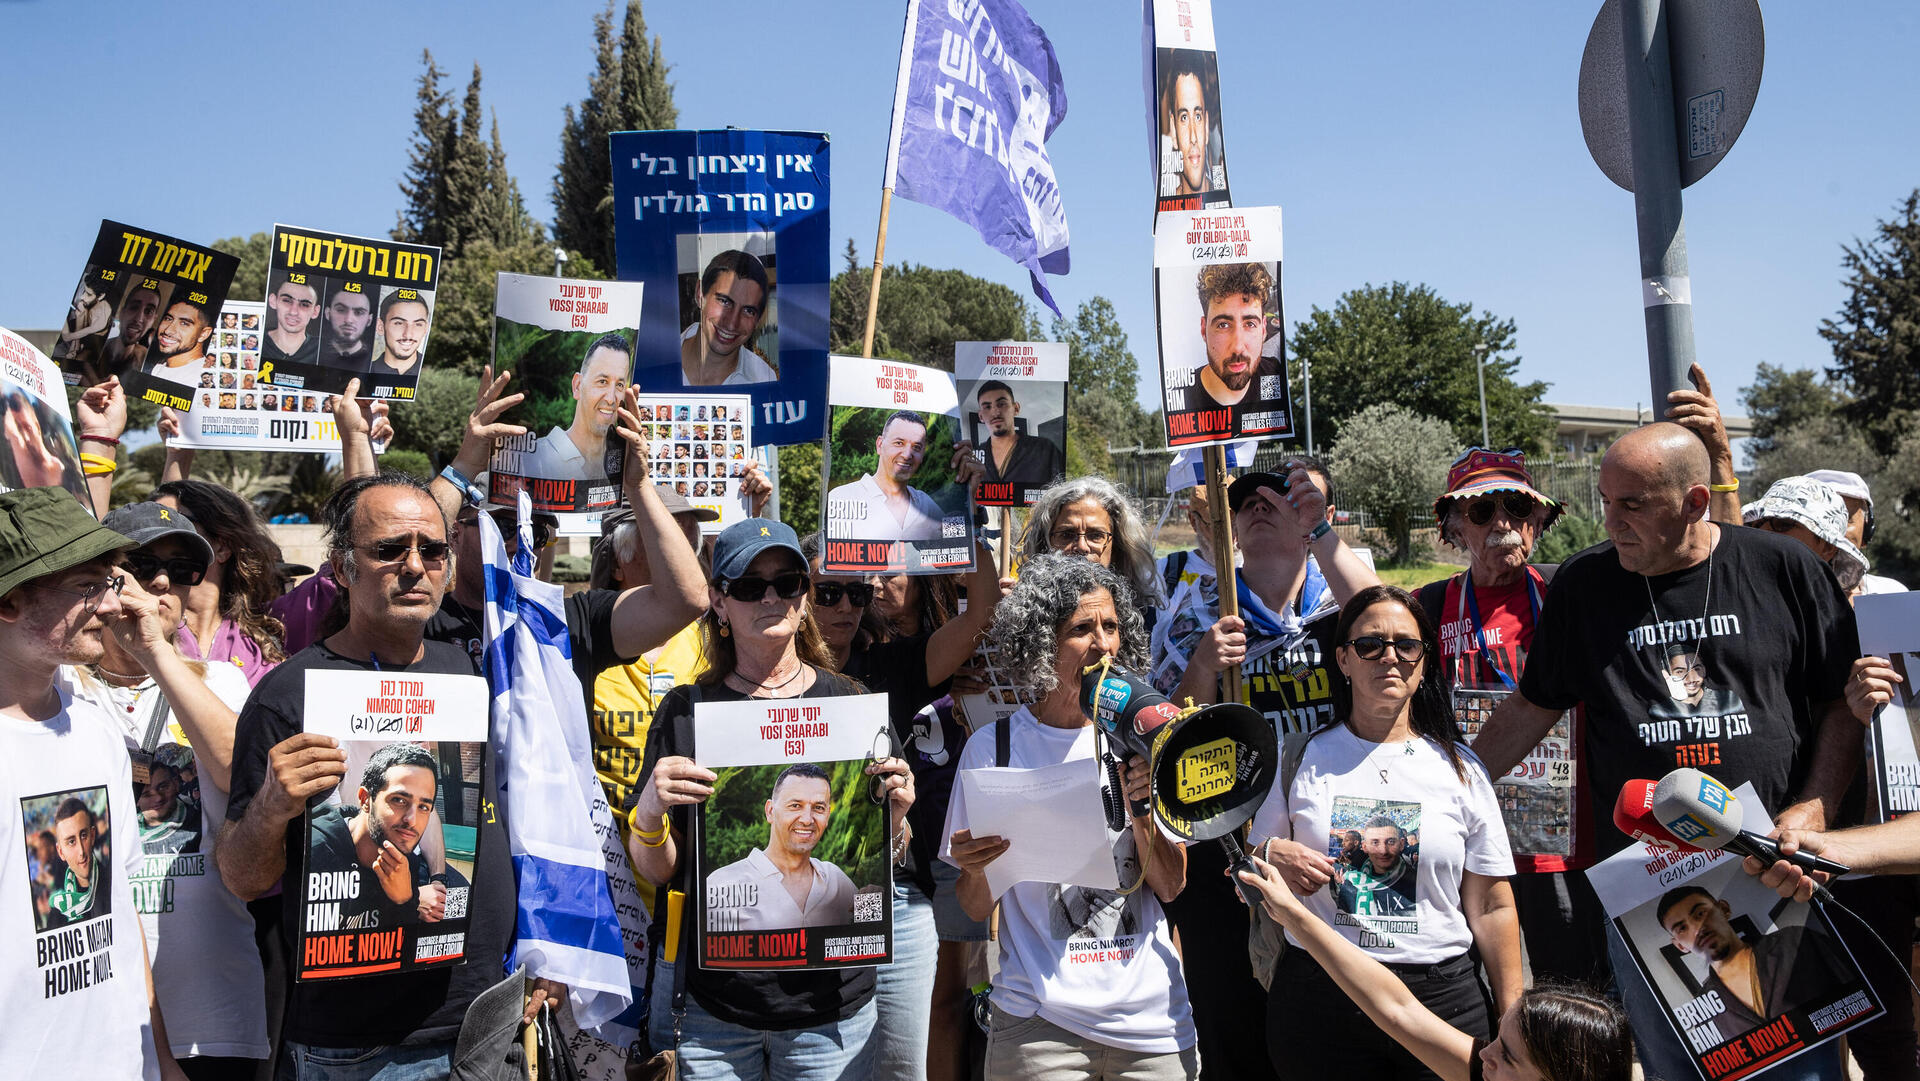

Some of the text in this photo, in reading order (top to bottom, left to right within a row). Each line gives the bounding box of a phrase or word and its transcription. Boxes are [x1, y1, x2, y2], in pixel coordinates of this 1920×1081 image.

[631, 152, 813, 181] אין ניצחון בלי
[1162, 151, 1184, 174] BRING
[1160, 173, 1178, 197] HIM
[634, 190, 815, 220] סגן הדר גולדין
[1233, 216, 1245, 228] גיא
[1186, 229, 1252, 244] GUY GILBOA-DALAL
[119, 232, 213, 284] אביתר דוד
[279, 233, 433, 283] רום ברסלבסקי
[101, 269, 116, 281] 7.25
[142, 279, 158, 290] 2.25
[290, 273, 306, 284] 7.25
[345, 282, 362, 293] 4.25
[398, 289, 417, 300] 2023
[559, 284, 602, 299] יוסי שרעבי
[189, 292, 209, 305] 2023
[549, 298, 609, 315] YOSSI SHARABI
[571, 314, 588, 329] (53)
[881, 364, 918, 379] יוסי שרעבי
[986, 356, 1038, 366] ROM BRASLAVSKI
[876, 378, 924, 393] YOSI SHARABI
[1165, 367, 1196, 388] BRING
[893, 391, 908, 404] (53)
[1167, 389, 1185, 412] HIM
[762, 399, 808, 425] עוז
[1168, 406, 1232, 437] HOME NOW!
[496, 431, 537, 453] BRING
[493, 450, 521, 473] HIM
[534, 478, 577, 502] NOW!
[984, 482, 1014, 500] NOW!
[827, 499, 868, 520] BRING
[827, 519, 853, 540] HIM
[827, 541, 906, 564] HOME NOW!
[920, 552, 970, 565] FAMILIES FORUM
[1471, 627, 1503, 649] HME
[1627, 614, 1741, 651] רום ברסלבסקי
[380, 680, 424, 697] נמרוד כהן
[366, 697, 435, 715] NIMROD COHEN
[767, 706, 821, 724] יוסי שרעבי
[351, 714, 375, 734] (21)
[593, 710, 657, 737] יפור
[760, 723, 829, 740] YOSI SHARABI
[1638, 713, 1752, 747] הבן שלי חטוף
[784, 740, 805, 757] (53)
[1676, 743, 1721, 767] בעזה
[1200, 760, 1229, 778] מתה
[1552, 761, 1570, 775] 48
[1186, 774, 1234, 798] אחרונה
[128, 854, 205, 878] ATAN HOME
[1645, 857, 1669, 876] ROM
[129, 878, 174, 914] OW!
[307, 871, 361, 902] BRING
[707, 883, 758, 908] BRING
[306, 902, 341, 933] HIM
[707, 908, 740, 932] HIM
[1390, 921, 1418, 934] HOME
[36, 918, 113, 968] BRING MATAN
[304, 926, 404, 967] HOME NOW!
[707, 929, 808, 959] HOME NOW!
[825, 934, 885, 947] HOSTAGES AND MISSING
[1069, 938, 1135, 951] BRING NIMROD
[1359, 930, 1395, 948] NOW!
[416, 941, 464, 960] FAMILIES FORUM
[825, 943, 886, 958] FAMILIES FORUM
[1070, 948, 1134, 964] HOME NOW!
[45, 951, 113, 999] HOME NOW!
[1673, 990, 1727, 1030] BRING
[1808, 1004, 1835, 1021] HOSTAGES
[1833, 999, 1844, 1010] AND
[1812, 998, 1874, 1033] FAMILIES FORUM
[1686, 1021, 1725, 1055] HIM
[1701, 1014, 1799, 1079] HOME NOW!
